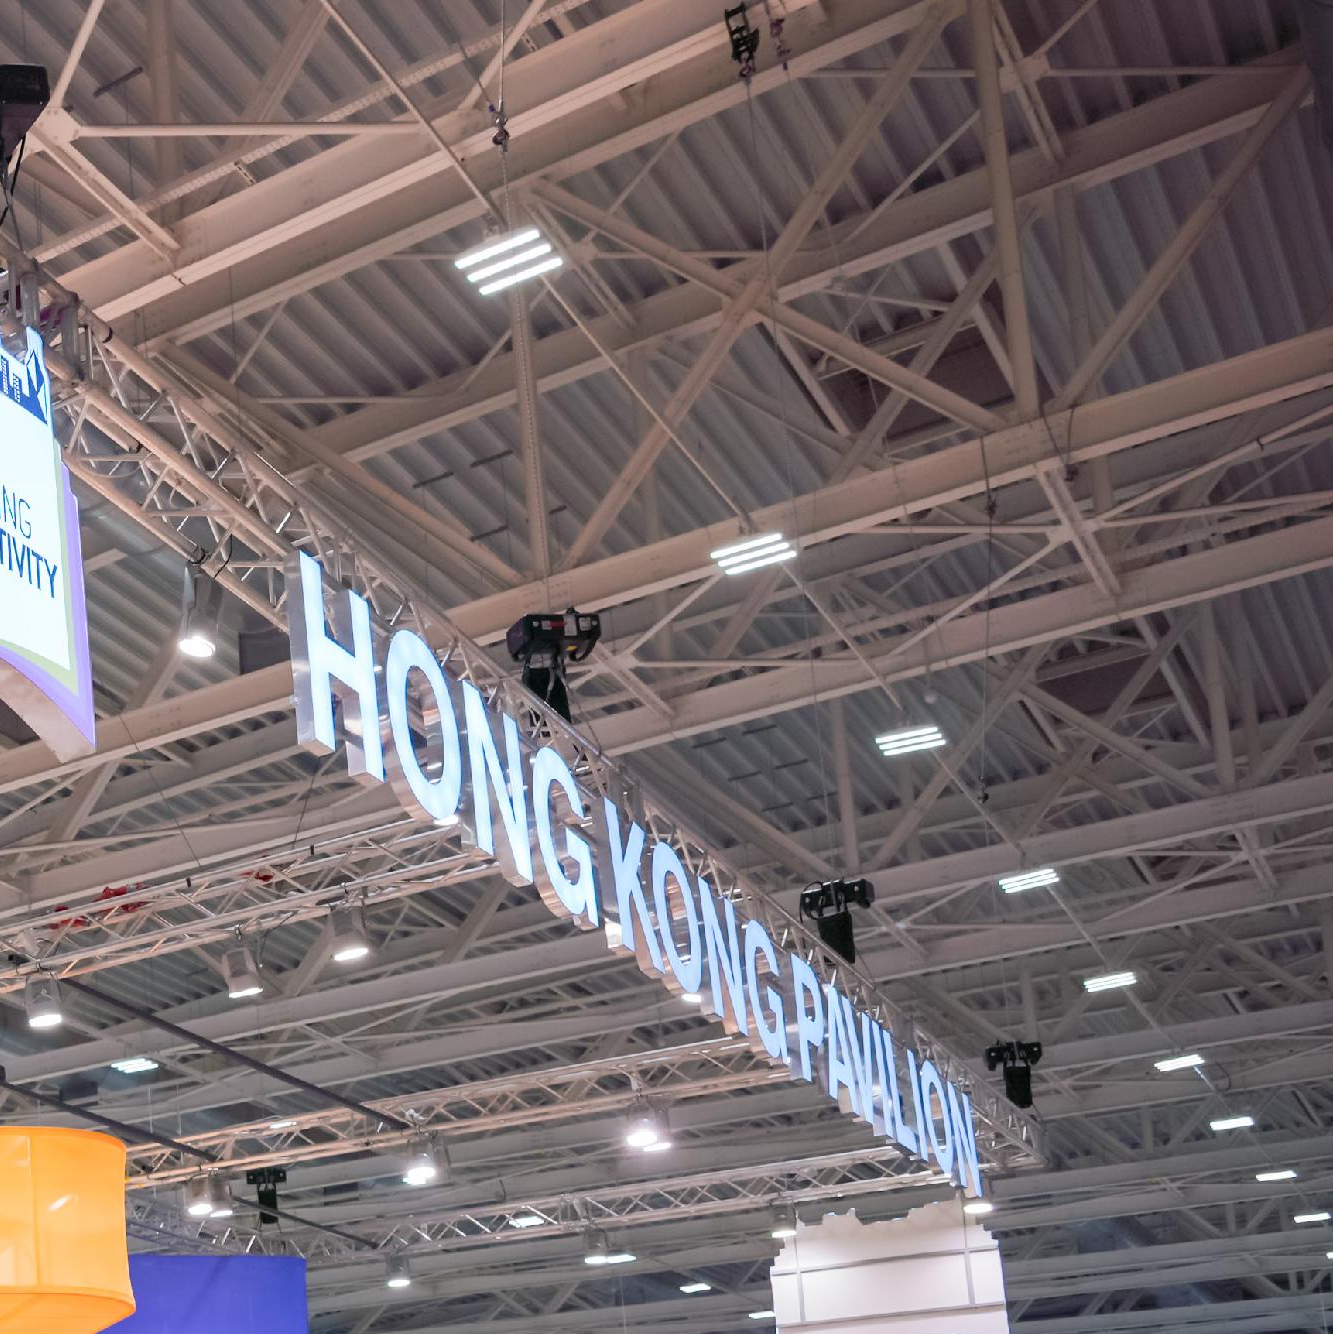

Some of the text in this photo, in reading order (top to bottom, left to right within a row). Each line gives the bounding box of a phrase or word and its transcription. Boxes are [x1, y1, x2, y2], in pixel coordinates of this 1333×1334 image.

[299, 550, 984, 1198] HONG KONG PAVILION
